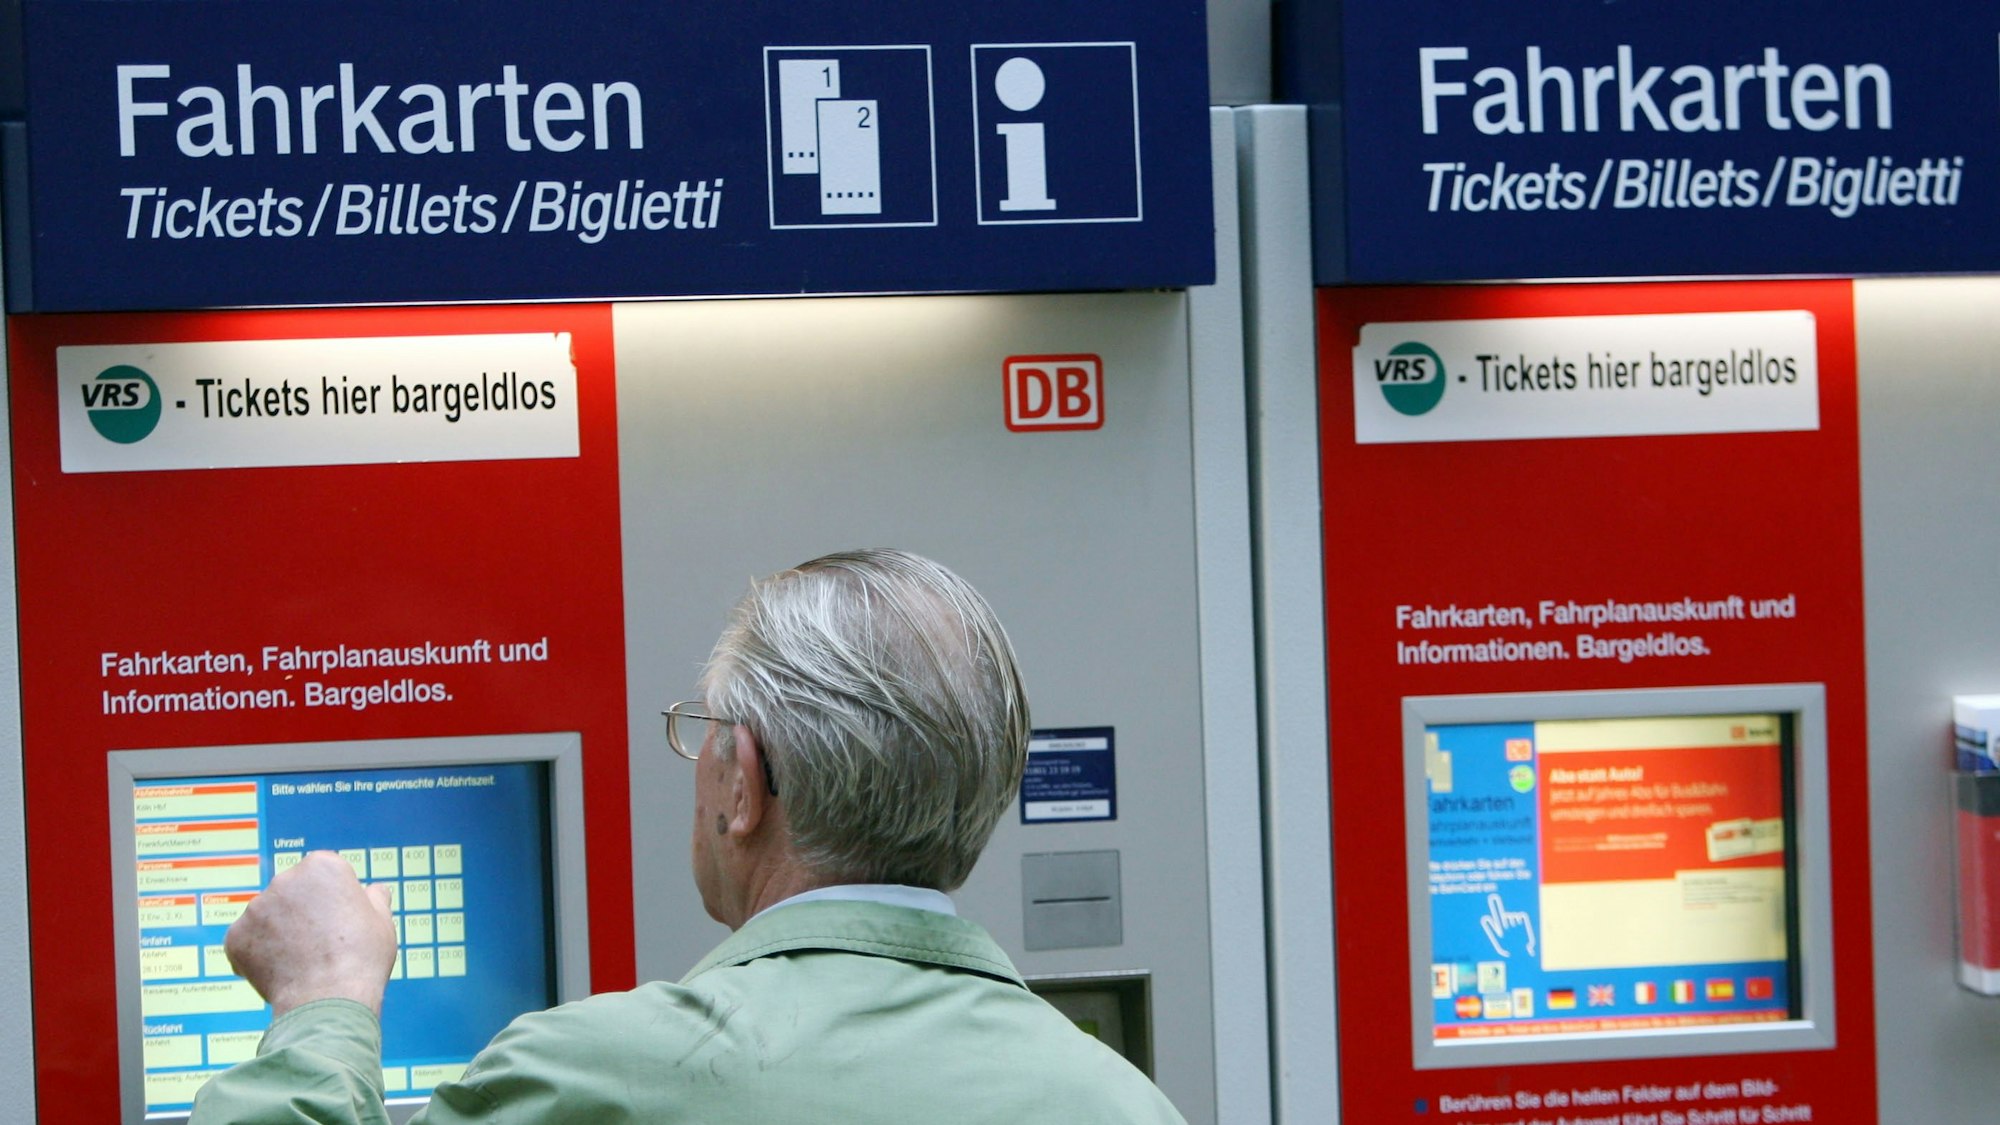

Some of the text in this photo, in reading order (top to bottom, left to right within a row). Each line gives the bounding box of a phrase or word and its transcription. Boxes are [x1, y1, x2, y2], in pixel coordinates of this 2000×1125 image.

[822, 67, 831, 88] 1
[1419, 45, 1892, 134] Fahrkarten
[116, 62, 644, 157] Fahrkarten
[857, 107, 871, 129] 2
[1374, 358, 1426, 382] VRS
[1475, 353, 1578, 392] Tickets
[1588, 351, 1641, 389] hier
[1651, 348, 1798, 396] bargeldlos
[81, 383, 140, 408] VRS
[196, 376, 310, 418] Tickets
[322, 374, 382, 416] hier
[392, 371, 556, 424] bargeldlos
[1016, 366, 1092, 419] DB
[1395, 594, 1796, 630] Fahrkarten, Fahrplanauskunft und
[101, 637, 548, 677] Fahrkarten, Fahrplanauskunft und
[1397, 632, 1711, 665] Informationen. Bargeldlos.
[102, 678, 454, 715] Informationen. Bargeldlos.
[272, 782, 295, 796] Bitte
[297, 780, 333, 794] wählen
[334, 779, 352, 792] Sie
[353, 778, 374, 791] Ihre
[375, 777, 434, 793] gewünschte
[273, 838, 305, 849] Uhrzeit
[1439, 1078, 1779, 1114] Berühren Sie die hellen Felder auf dem Bild-
[1687, 1108, 1737, 1125] Schritt
[1761, 1103, 1812, 1122] Schritt
